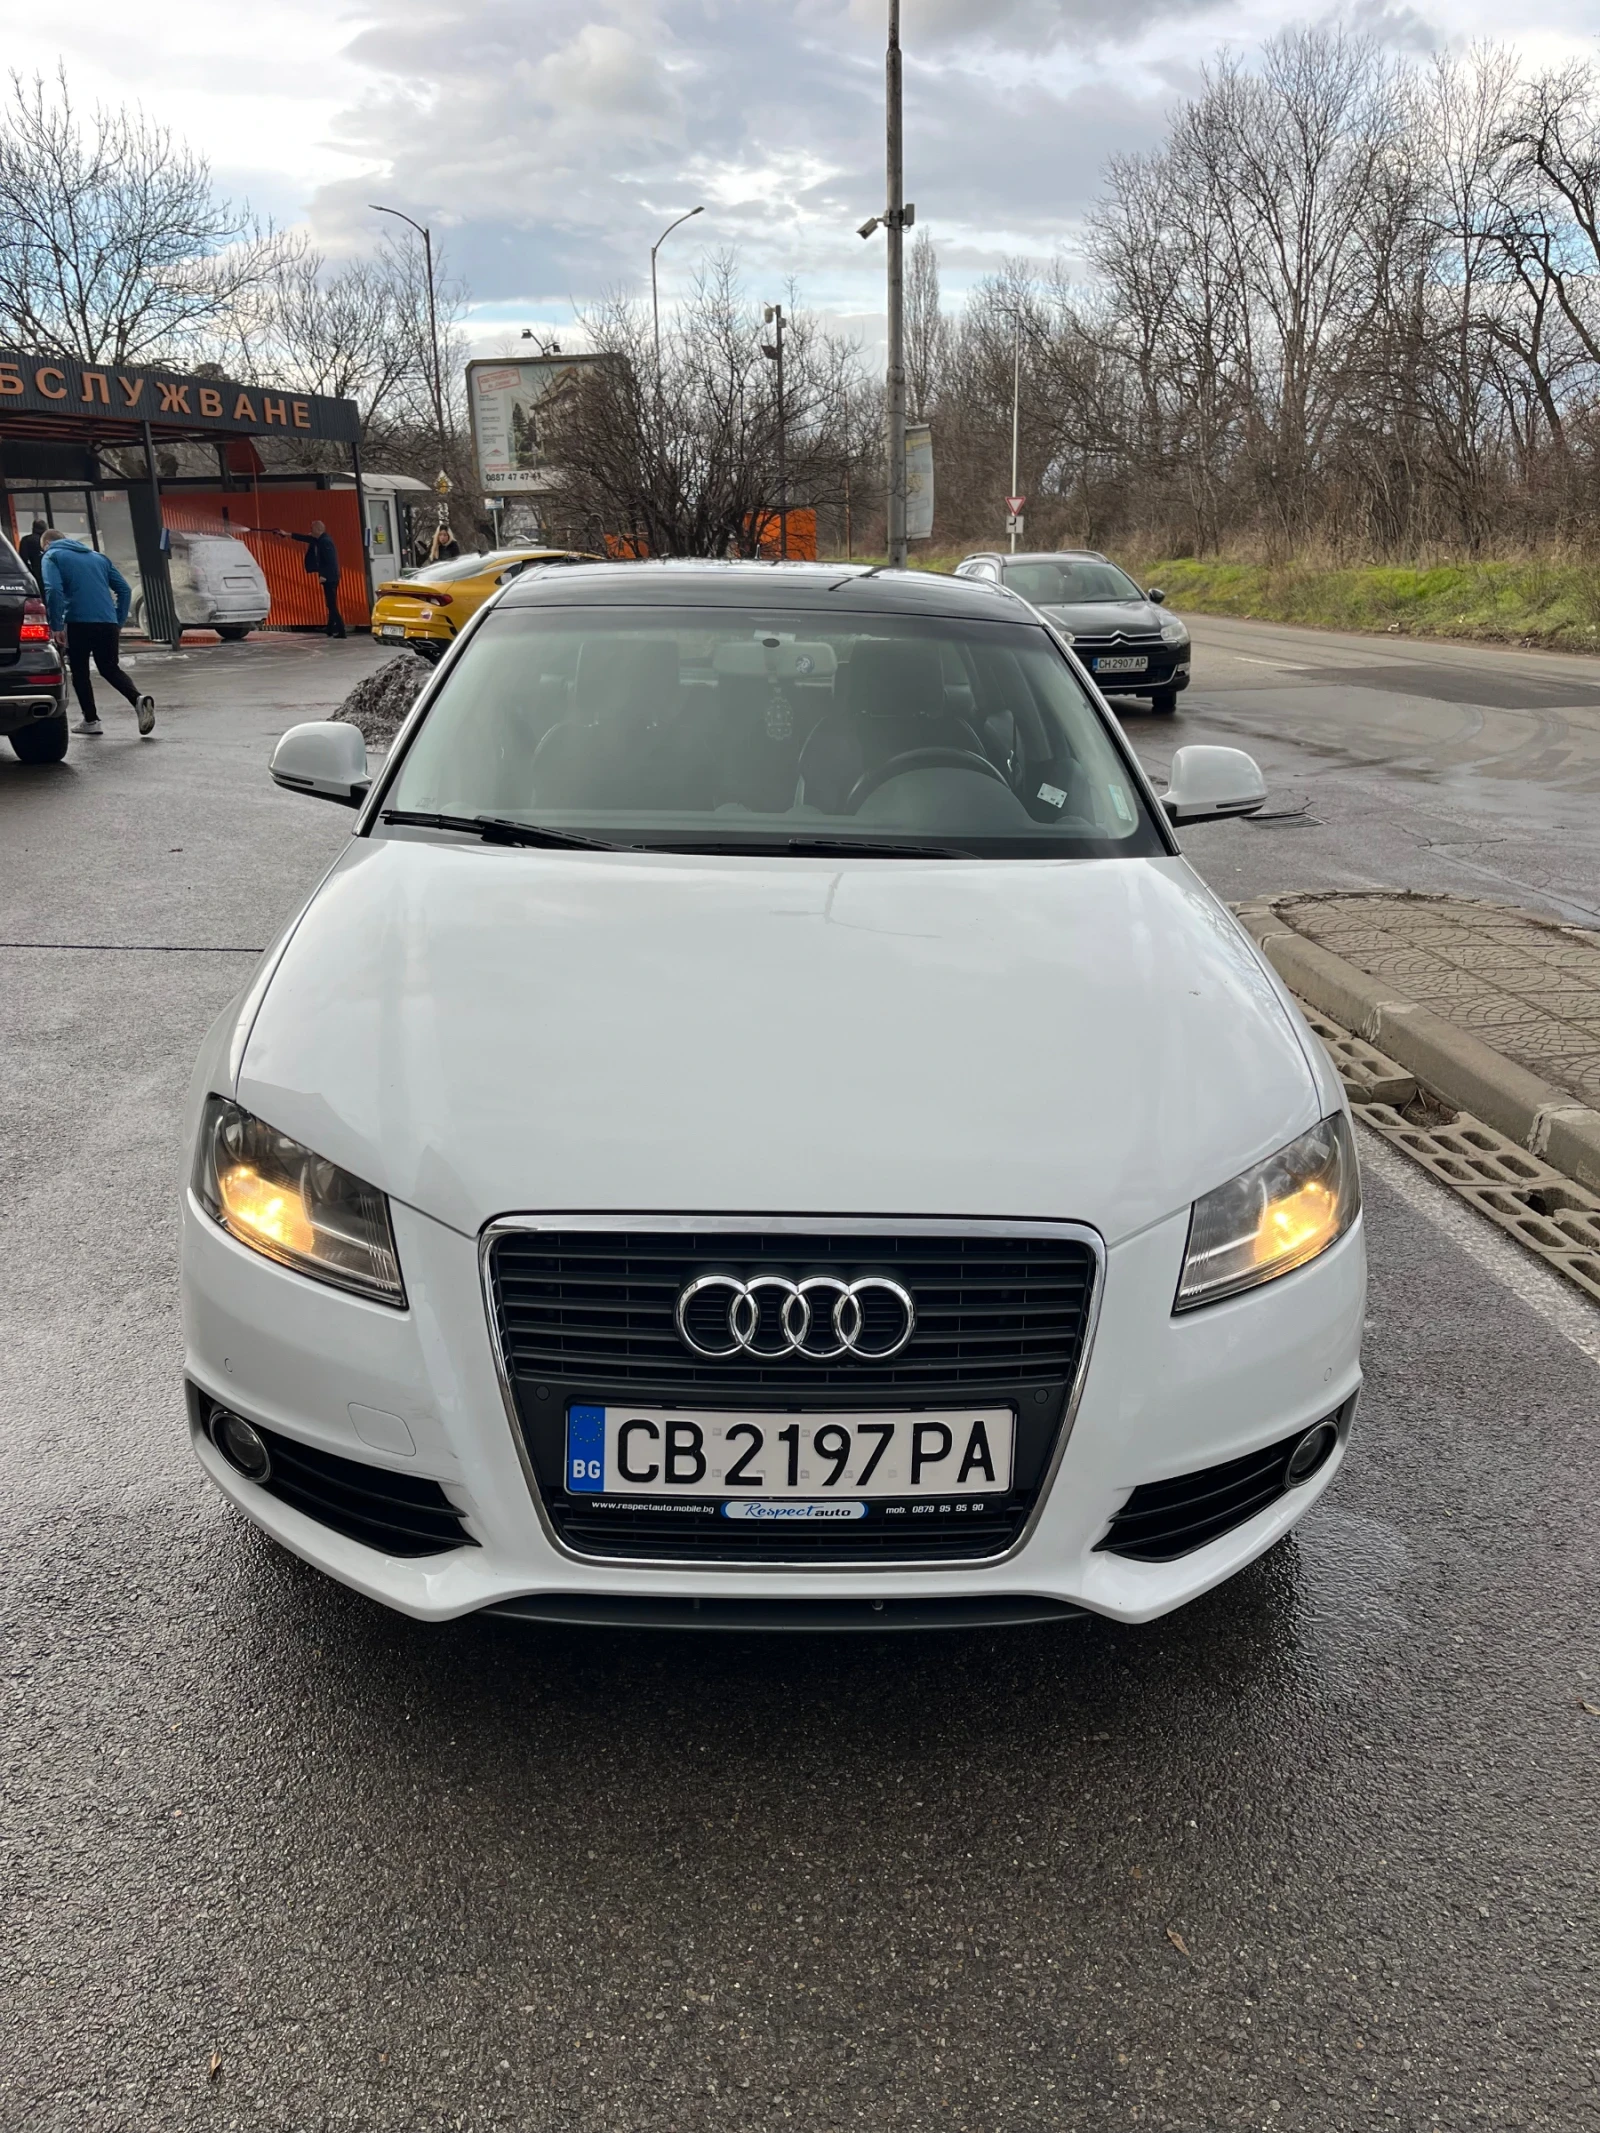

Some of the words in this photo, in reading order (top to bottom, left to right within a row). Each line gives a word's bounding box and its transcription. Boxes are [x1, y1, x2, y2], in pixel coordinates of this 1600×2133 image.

[0, 362, 312, 429] БСЛУЖВАНЕ
[485, 473, 505, 482] 0887
[508, 473, 518, 481] 47
[520, 472, 530, 481] 47
[1099, 659, 1111, 669] CH
[1112, 658, 1134, 669] 2907
[1135, 657, 1147, 668] AP
[617, 1418, 707, 1485] CB
[724, 1422, 895, 1487] 2197
[910, 1420, 996, 1485] PA
[572, 1459, 601, 1479] BG
[591, 1501, 715, 1515] www.respectauto.mobile.bg
[885, 1504, 908, 1514] mob.
[912, 1504, 936, 1514] 0879
[938, 1504, 952, 1513] 95
[955, 1503, 968, 1513] 95
[971, 1502, 985, 1512] 90
